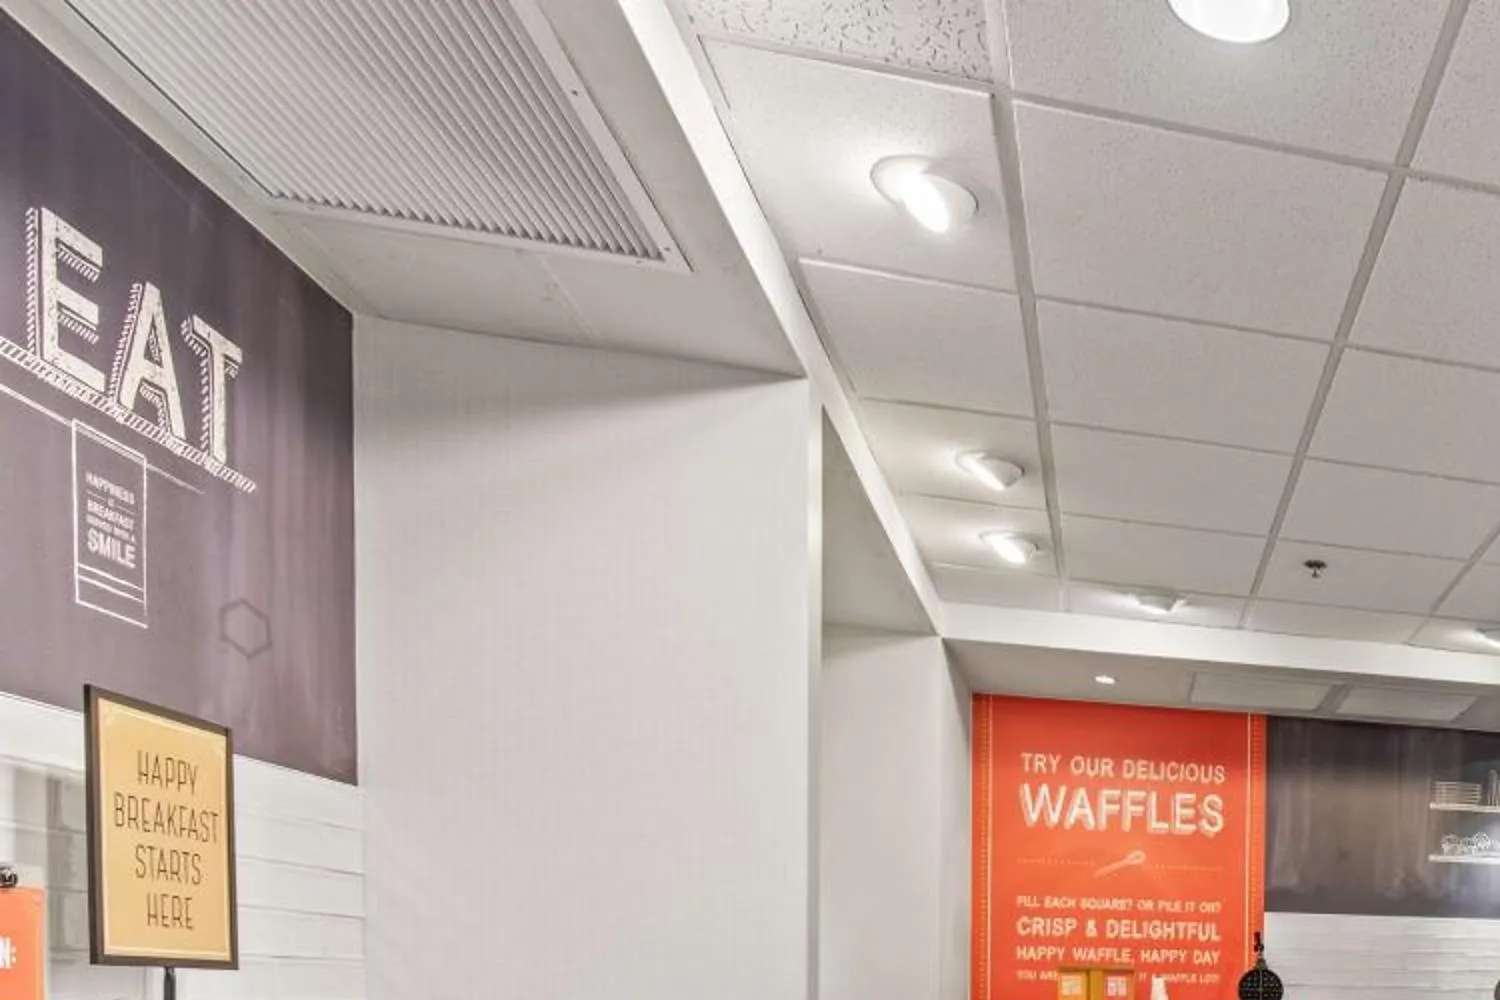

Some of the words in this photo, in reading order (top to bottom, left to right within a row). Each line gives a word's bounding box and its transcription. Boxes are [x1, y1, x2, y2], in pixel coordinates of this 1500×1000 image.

[27, 206, 243, 466] EAT
[87, 527, 136, 569] SMILE
[137, 750, 199, 794] HAPPY
[1021, 752, 1061, 775] TRY
[1070, 755, 1114, 777] OUR
[1123, 759, 1226, 784] DELICIOUS
[114, 792, 218, 844] BREAKFAST
[1019, 782, 1225, 838] WAFFLES
[135, 844, 201, 886] STARTS
[147, 892, 194, 931] HERE
[1017, 896, 1040, 907] FILL
[1044, 896, 1076, 909] EACH
[1137, 899, 1154, 911] OR
[1185, 901, 1196, 912] IT
[1016, 916, 1077, 937] CRISP
[1085, 919, 1098, 937] &
[1105, 919, 1221, 941] DELIGHTFUL
[1016, 945, 1065, 961] HAPPY
[1141, 949, 1187, 963] HAPPY
[1193, 950, 1219, 964] DAY
